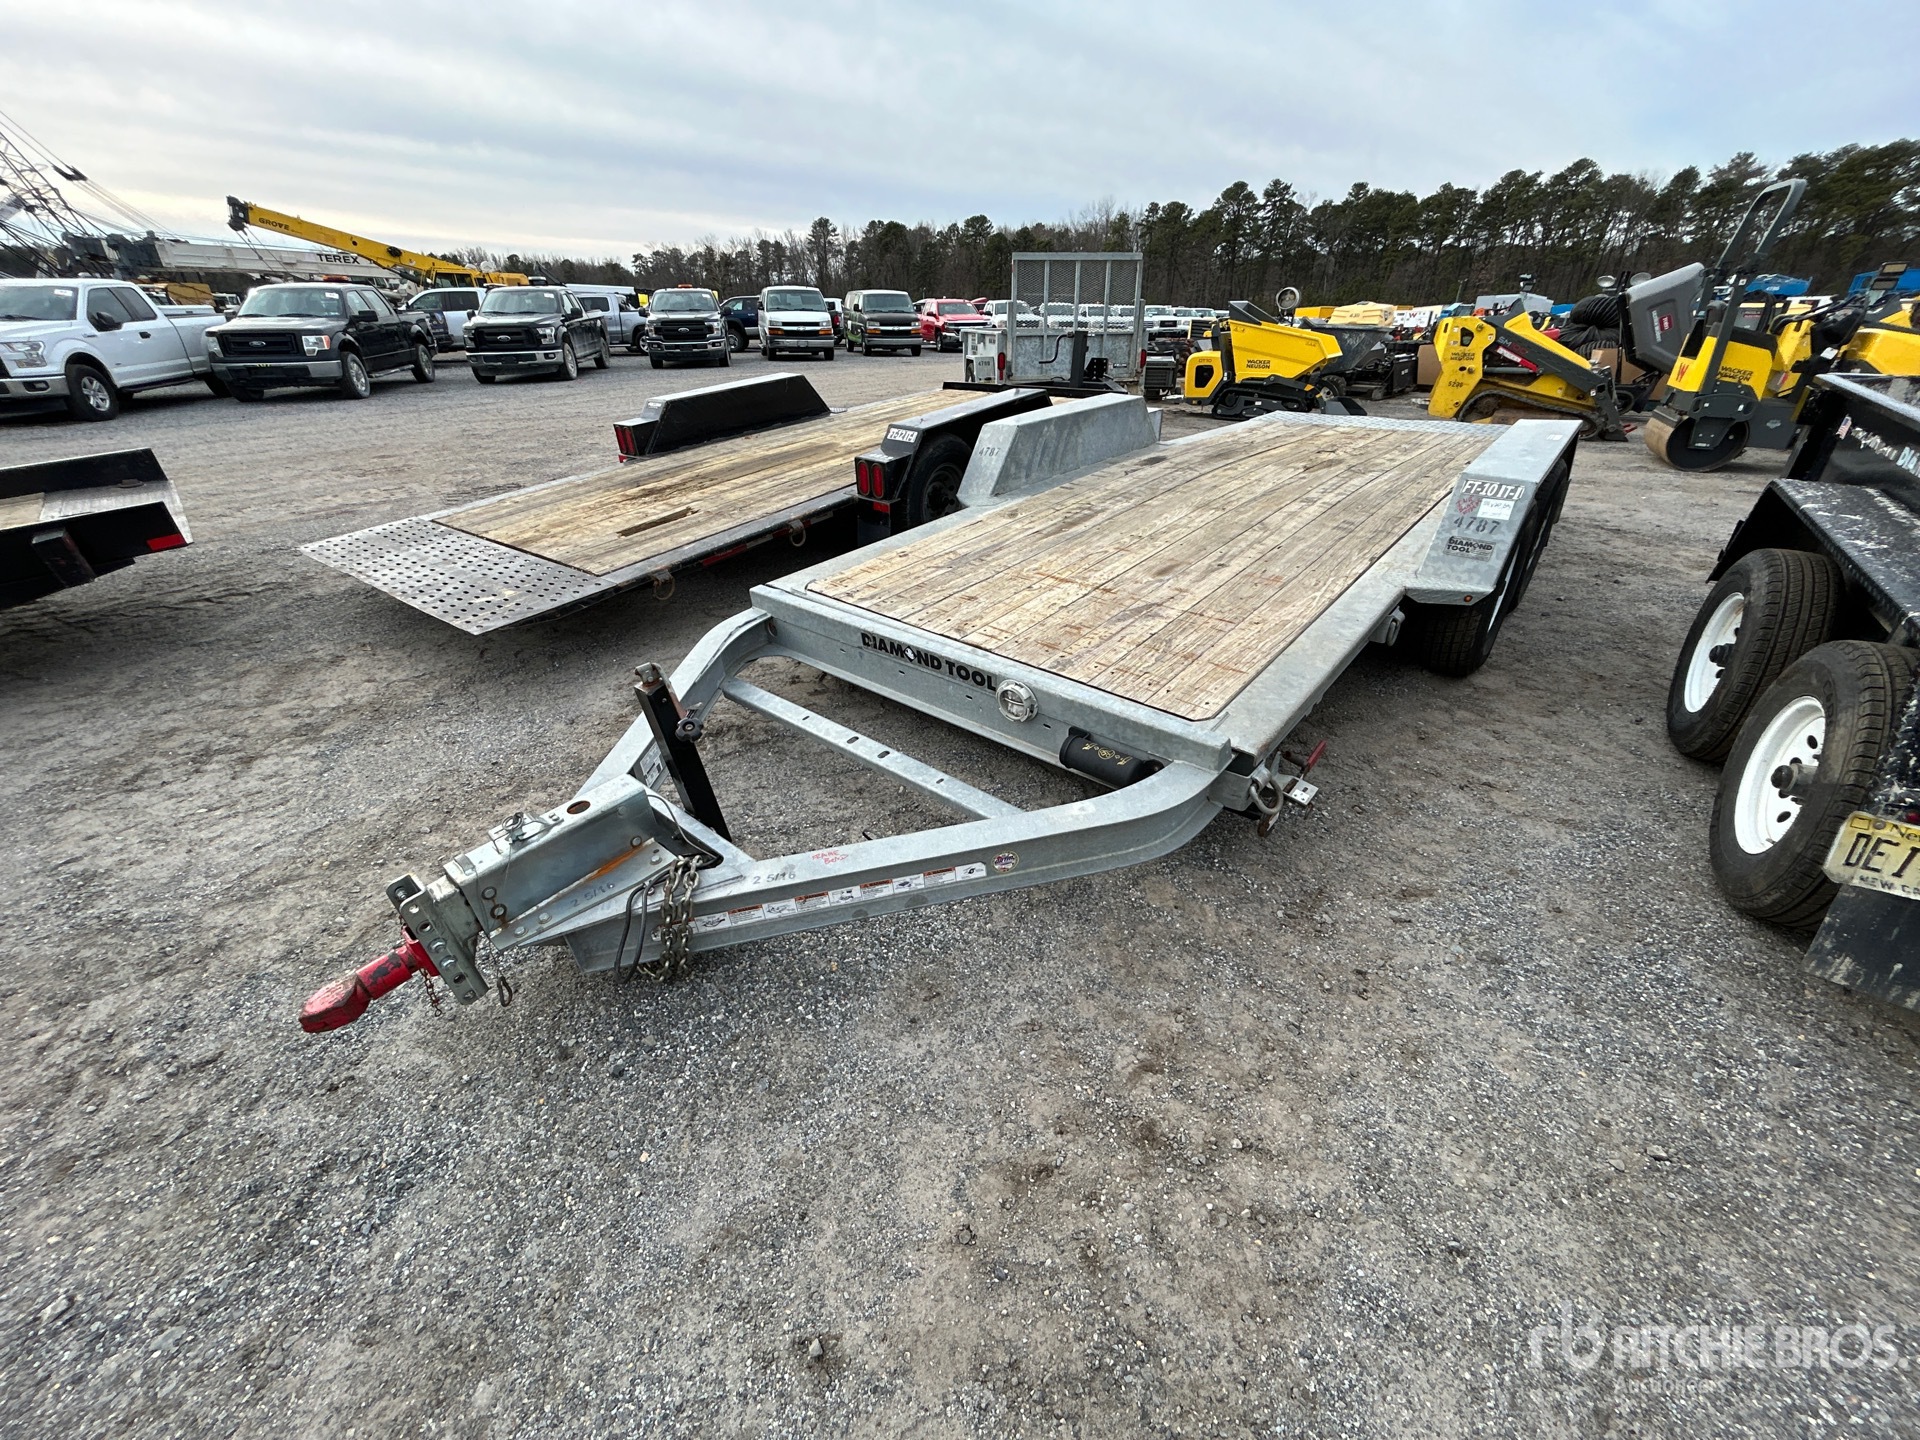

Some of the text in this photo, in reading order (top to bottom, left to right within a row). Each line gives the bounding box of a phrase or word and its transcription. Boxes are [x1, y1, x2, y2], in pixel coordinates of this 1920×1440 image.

[258, 217, 290, 231] GROVE
[316, 253, 360, 265] TEREX
[1721, 365, 1753, 376] WACKER
[979, 447, 1001, 457] 4787
[1462, 480, 1499, 496] FT-10
[1453, 517, 1500, 535] 4787
[1446, 544, 1471, 554] TOOL
[1449, 536, 1493, 551] DIAMOND
[860, 632, 997, 691] DIAMOND TOOL
